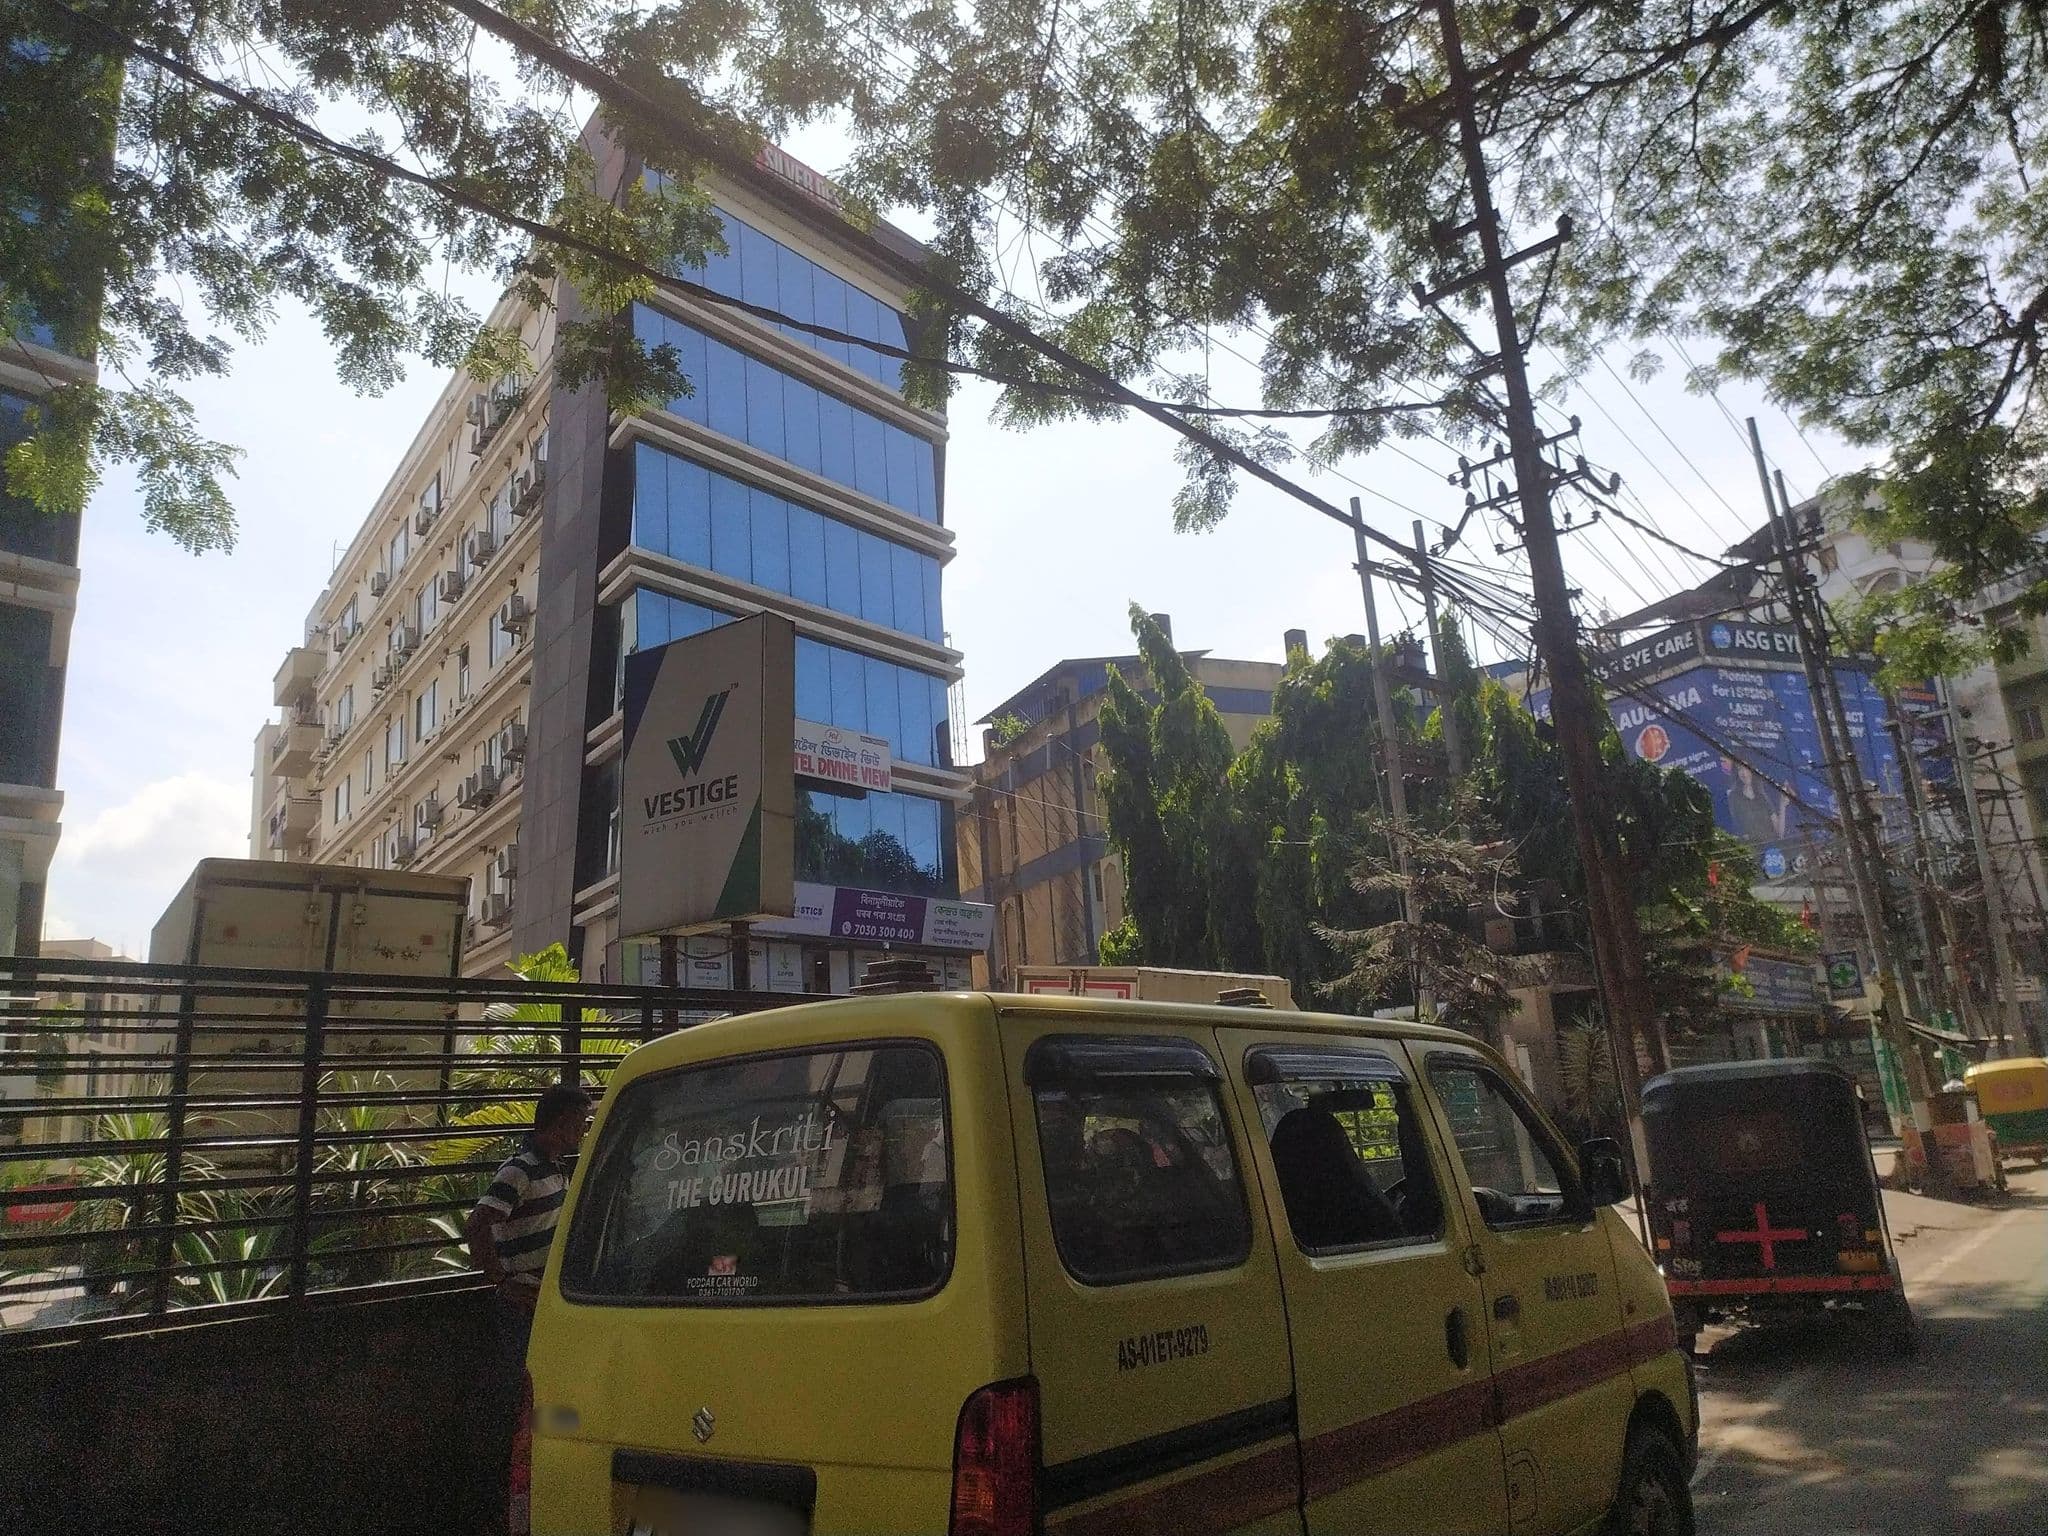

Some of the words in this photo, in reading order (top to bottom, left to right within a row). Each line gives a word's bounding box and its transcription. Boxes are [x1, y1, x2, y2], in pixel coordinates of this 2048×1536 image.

[1623, 648, 1651, 672] EYE
[1655, 630, 1694, 658] CARE
[1735, 629, 1770, 652] ASG
[794, 752, 815, 774] TEL
[818, 757, 858, 782] DIVINE
[861, 766, 890, 788] VIEW
[644, 774, 738, 819] VESTIGE
[798, 906, 823, 916] STICS
[854, 923, 877, 937] 7030
[879, 926, 896, 939] 300
[898, 927, 915, 941] 400
[654, 1110, 836, 1171] Sanskriti
[667, 1178, 704, 1210] THE
[709, 1166, 811, 1207] GURUKUL
[1119, 1325, 1208, 1371] AS-01ET-9279
